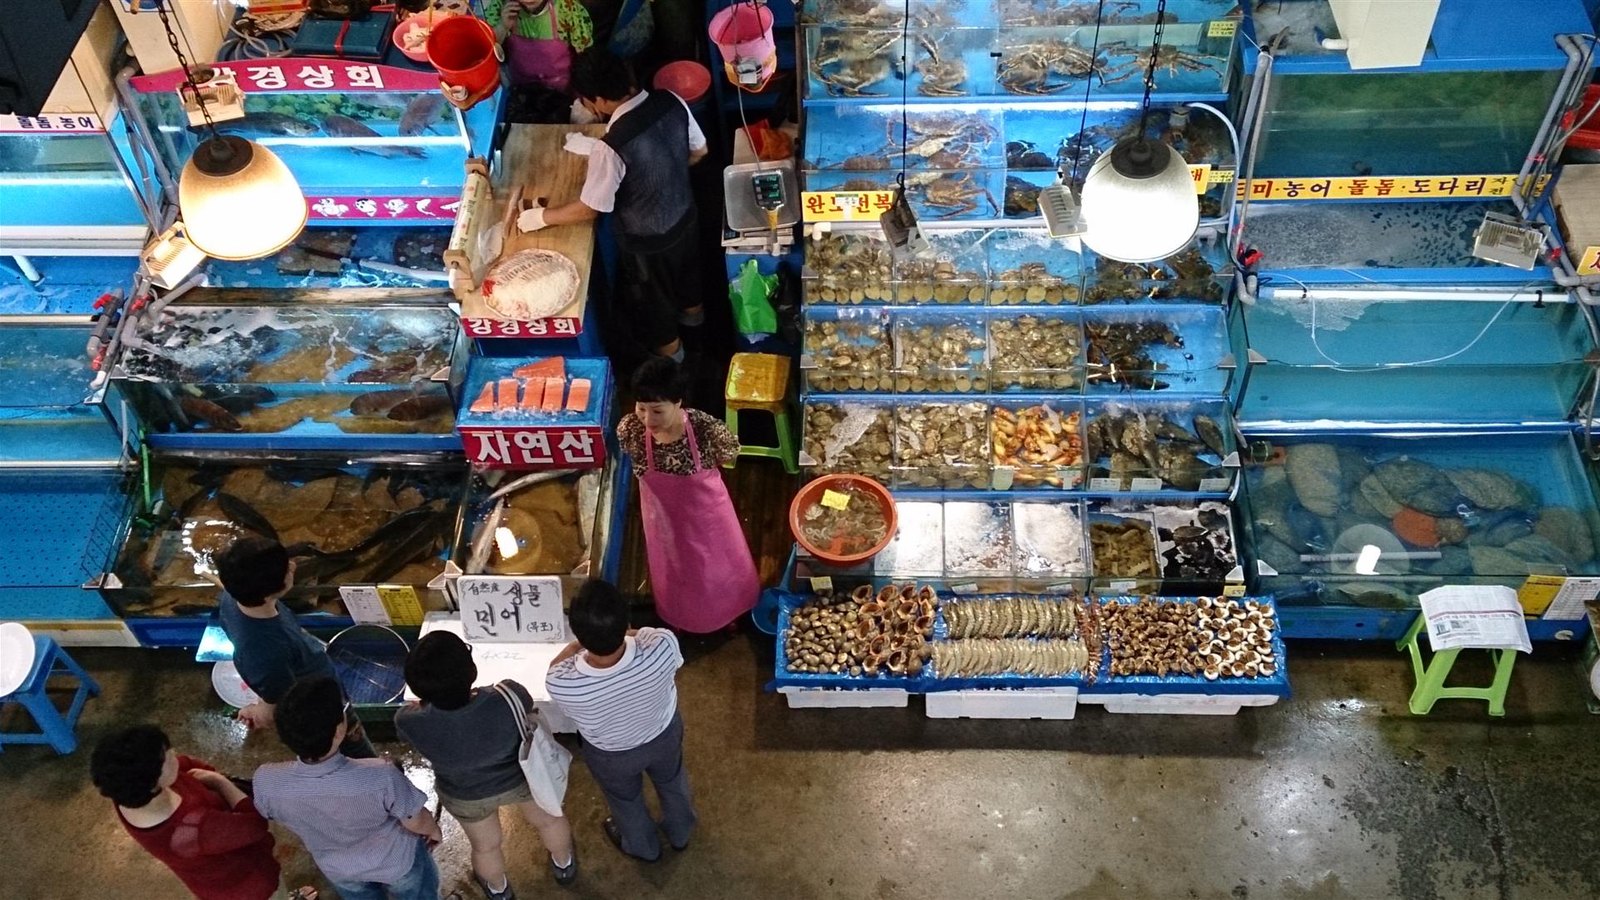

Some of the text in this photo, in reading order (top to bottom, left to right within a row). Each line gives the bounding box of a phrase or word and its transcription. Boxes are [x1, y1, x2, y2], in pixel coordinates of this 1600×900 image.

[1408, 177, 1487, 195] 도다리
[467, 318, 577, 335] 강경상회
[472, 429, 595, 464] 자연산
[474, 602, 520, 637] 민어
